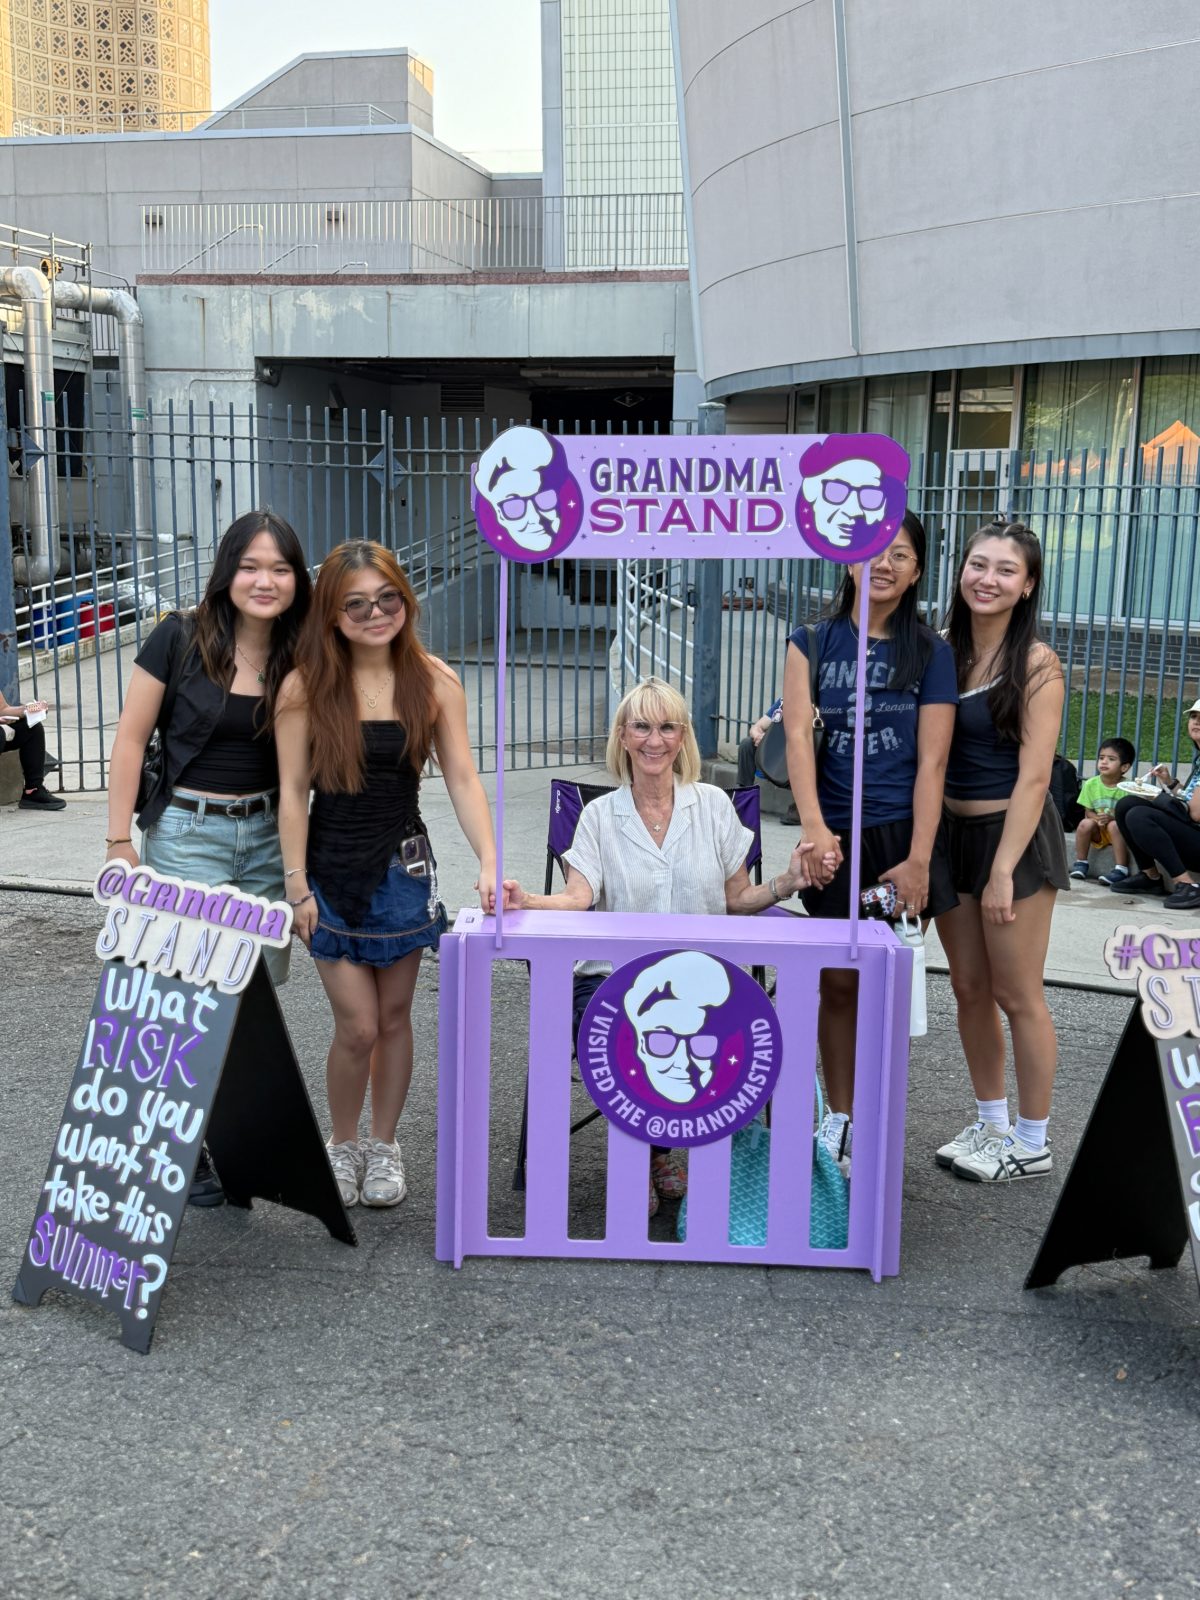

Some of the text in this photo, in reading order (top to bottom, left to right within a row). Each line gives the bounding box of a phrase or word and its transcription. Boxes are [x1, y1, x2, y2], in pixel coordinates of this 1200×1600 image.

[589, 457, 786, 495] GRANDMA
[589, 498, 786, 535] STAND
[875, 701, 915, 714] League
[96, 864, 287, 941] @Grandma
[99, 906, 256, 987] STAND
[103, 966, 219, 1033] What
[82, 1016, 203, 1089] RISK
[588, 1000, 773, 1138] I VISITED THE @GRANDMASTAND
[73, 1068, 204, 1145] do you
[149, 1142, 186, 1193] to
[44, 1165, 173, 1244] take this
